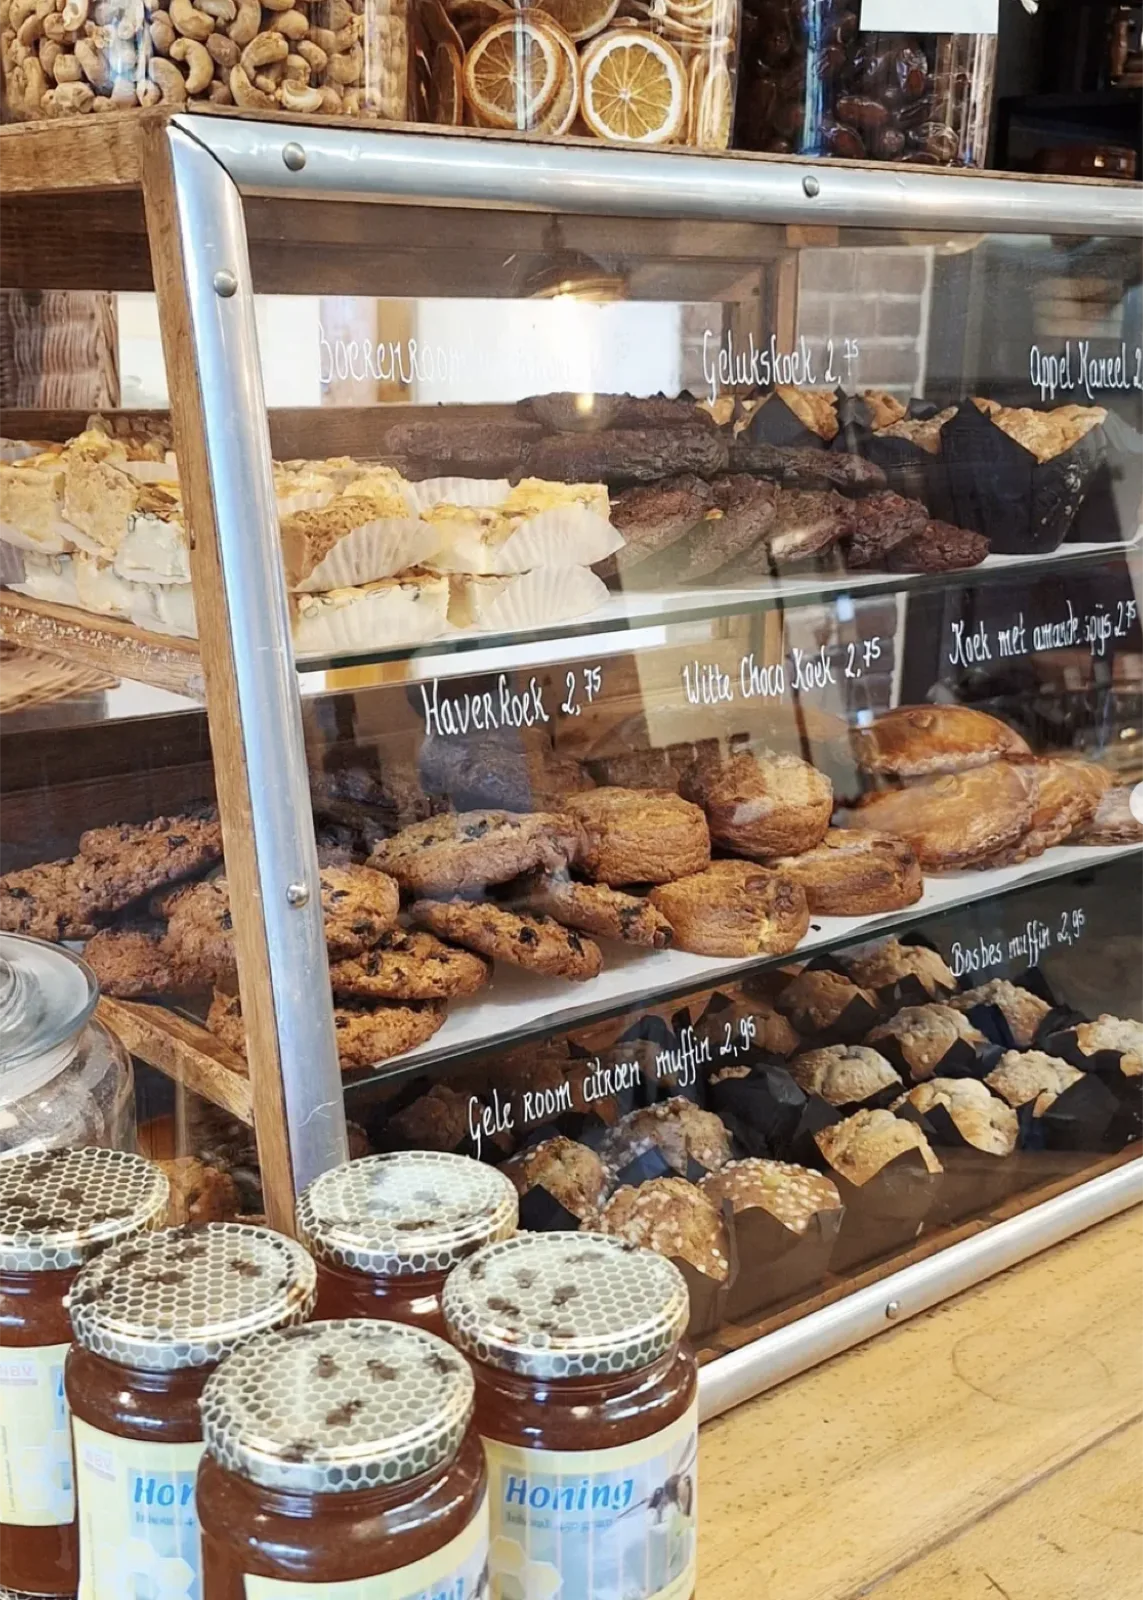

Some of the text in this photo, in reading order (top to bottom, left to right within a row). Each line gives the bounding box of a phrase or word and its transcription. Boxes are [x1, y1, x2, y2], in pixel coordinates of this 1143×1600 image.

[703, 329, 816, 407] Gelukskoek
[1030, 340, 1075, 402] Appel
[1078, 340, 1131, 400] Kaneel
[949, 619, 992, 668] Koek
[998, 611, 1028, 658] met
[683, 660, 734, 704] Witte
[741, 652, 785, 698] Choco
[791, 646, 836, 692] Koek
[1008, 919, 1052, 968] muffin
[468, 1088, 514, 1160] Gele
[656, 1025, 713, 1087] muffin
[134, 1476, 194, 1506] Hon
[505, 1475, 634, 1512] Honing
